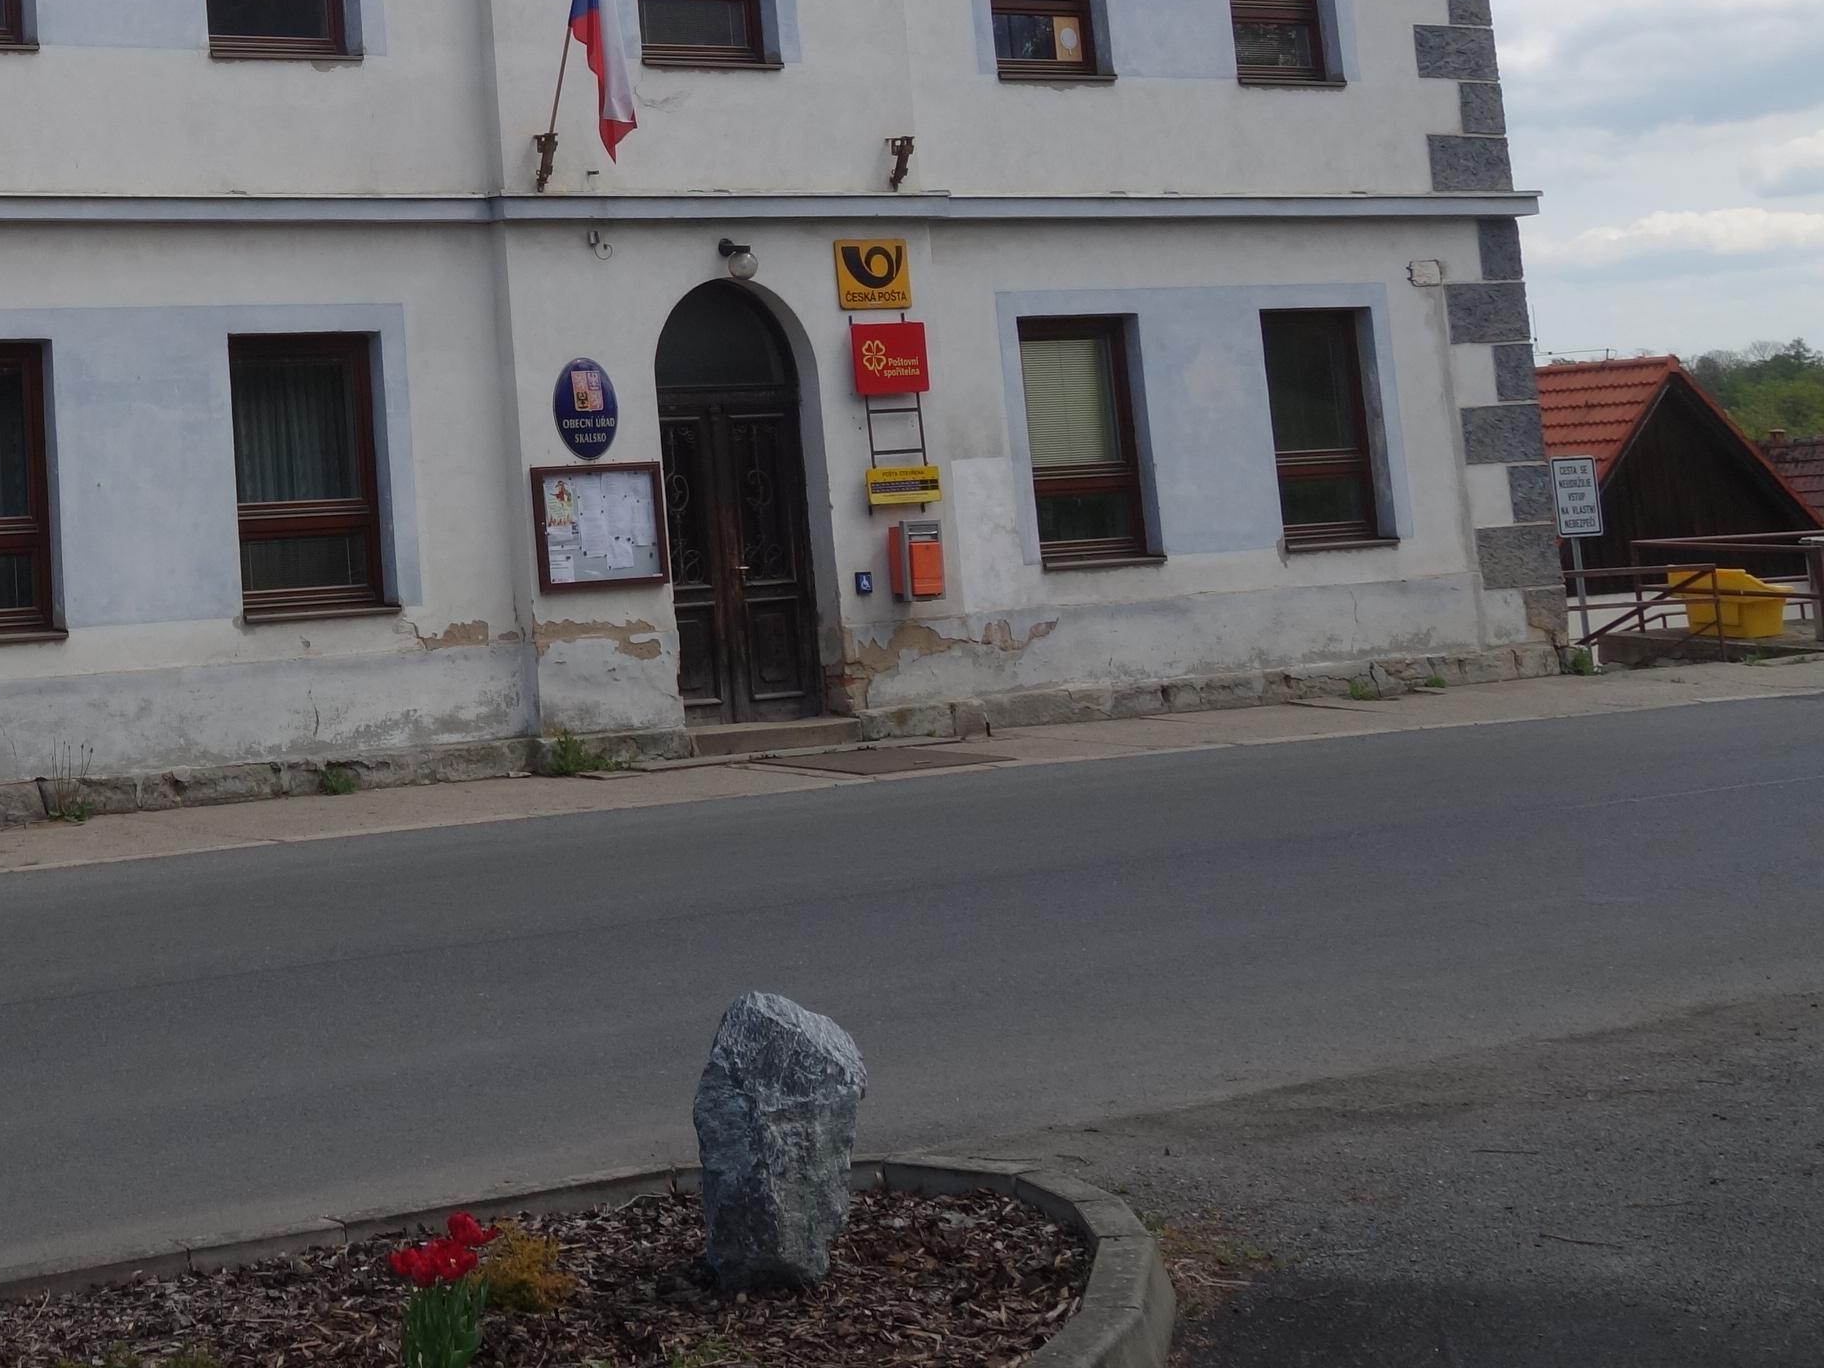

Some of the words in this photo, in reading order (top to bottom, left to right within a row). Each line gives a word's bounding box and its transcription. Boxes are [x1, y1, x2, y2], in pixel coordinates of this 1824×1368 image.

[845, 290, 876, 302] ČESKÁ
[878, 289, 907, 302] POŠTA
[887, 357, 919, 366] Poštovní
[883, 367, 920, 378] spořitelna
[563, 416, 593, 429] OBECNÍ
[595, 415, 615, 428] ÚŘAD
[575, 433, 606, 443] SKALSKO
